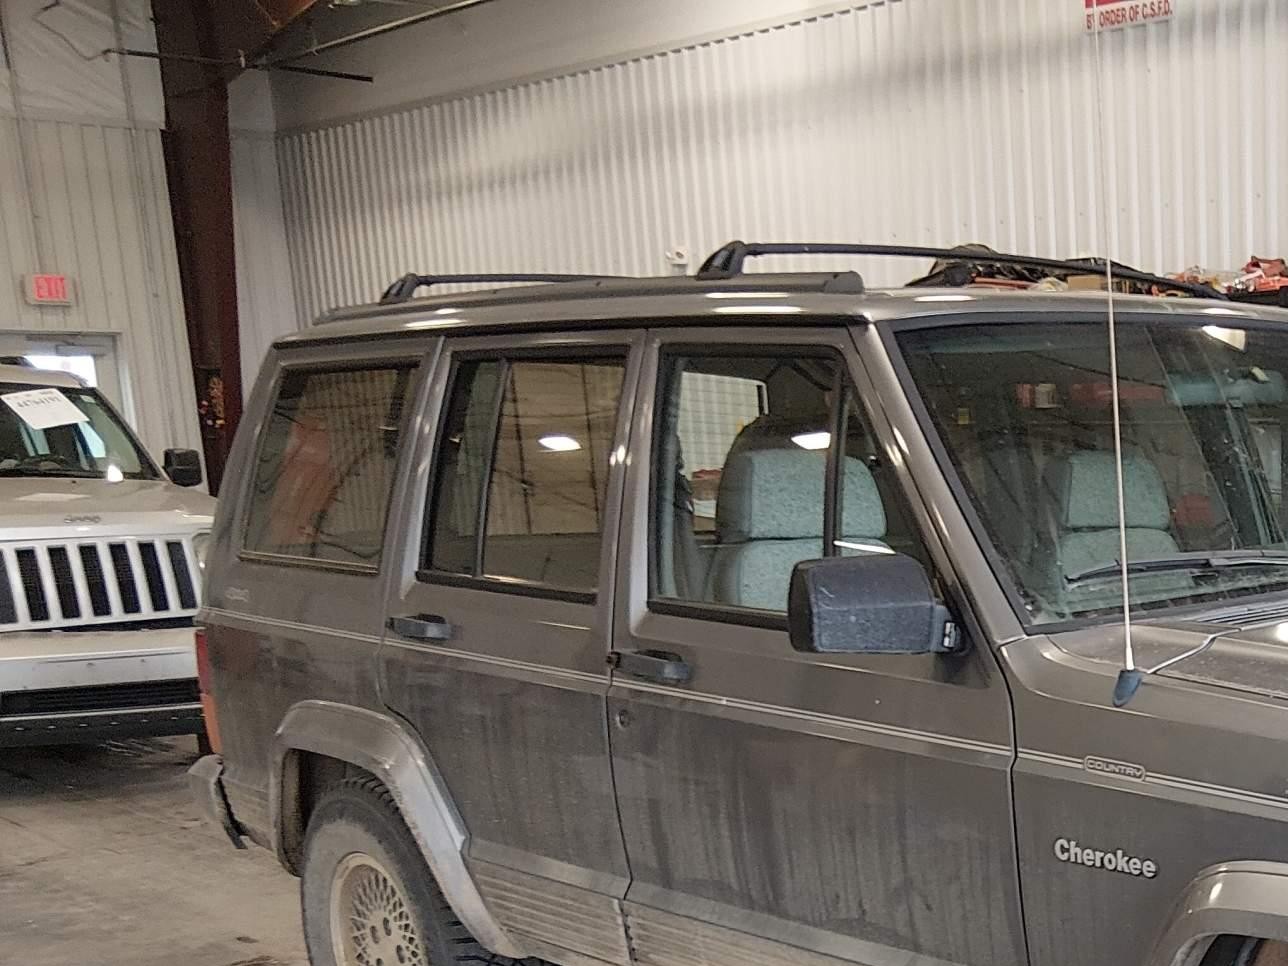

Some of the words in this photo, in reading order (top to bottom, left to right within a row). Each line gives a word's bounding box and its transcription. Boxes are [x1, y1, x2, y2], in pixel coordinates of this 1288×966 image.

[1099, 8, 1128, 28] ORDER
[1129, 5, 1140, 22] OF
[1086, 758, 1143, 778] COUNTRY
[1053, 837, 1158, 879] Cherokee
